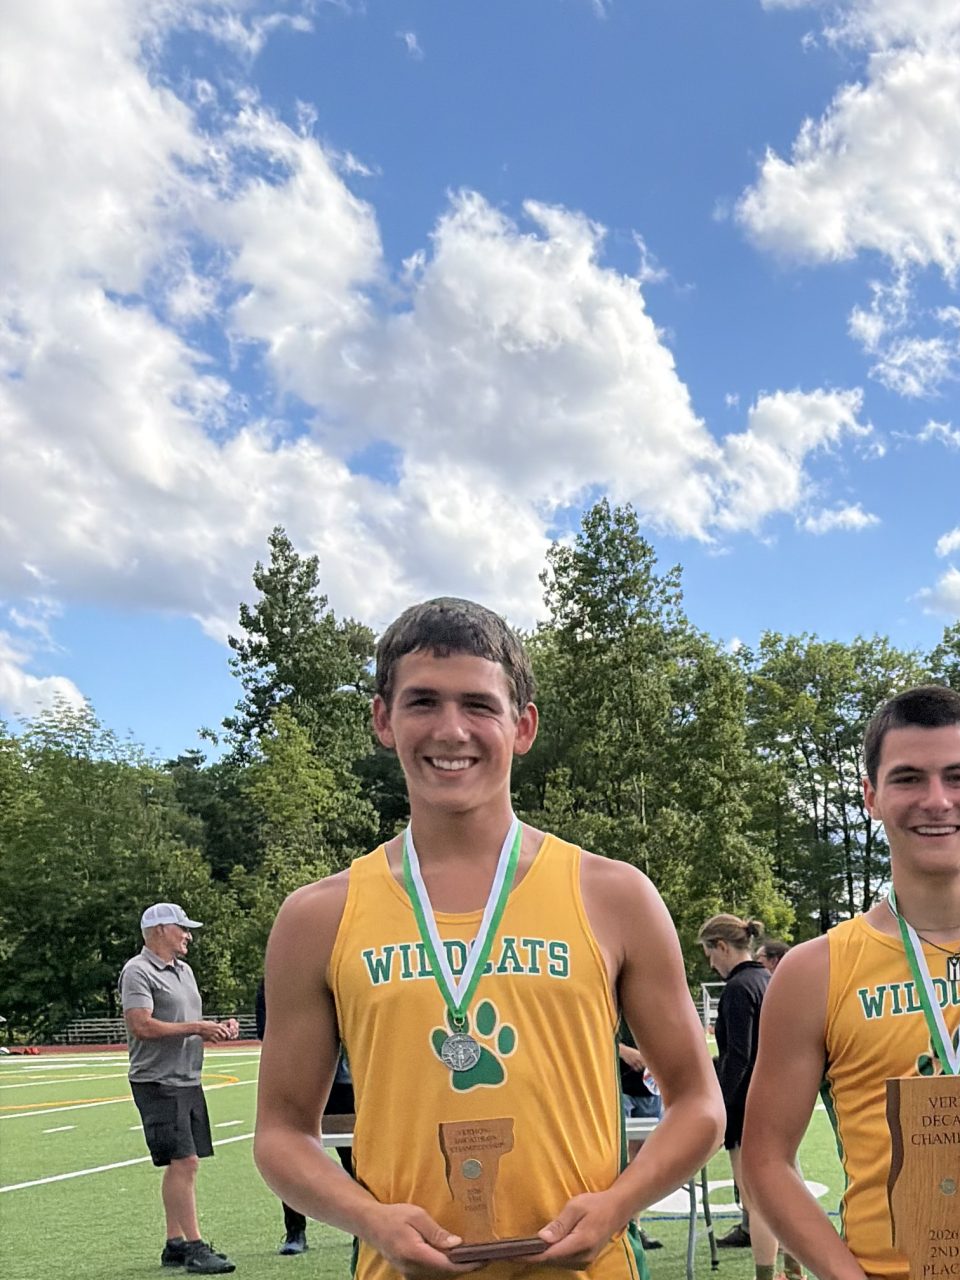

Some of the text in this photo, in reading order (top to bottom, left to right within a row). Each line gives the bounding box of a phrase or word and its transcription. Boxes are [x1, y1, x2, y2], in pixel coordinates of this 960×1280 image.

[362, 937, 570, 985] WILDATS
[929, 1228, 959, 1241] 2026
[930, 1245, 960, 1258] 2ND
